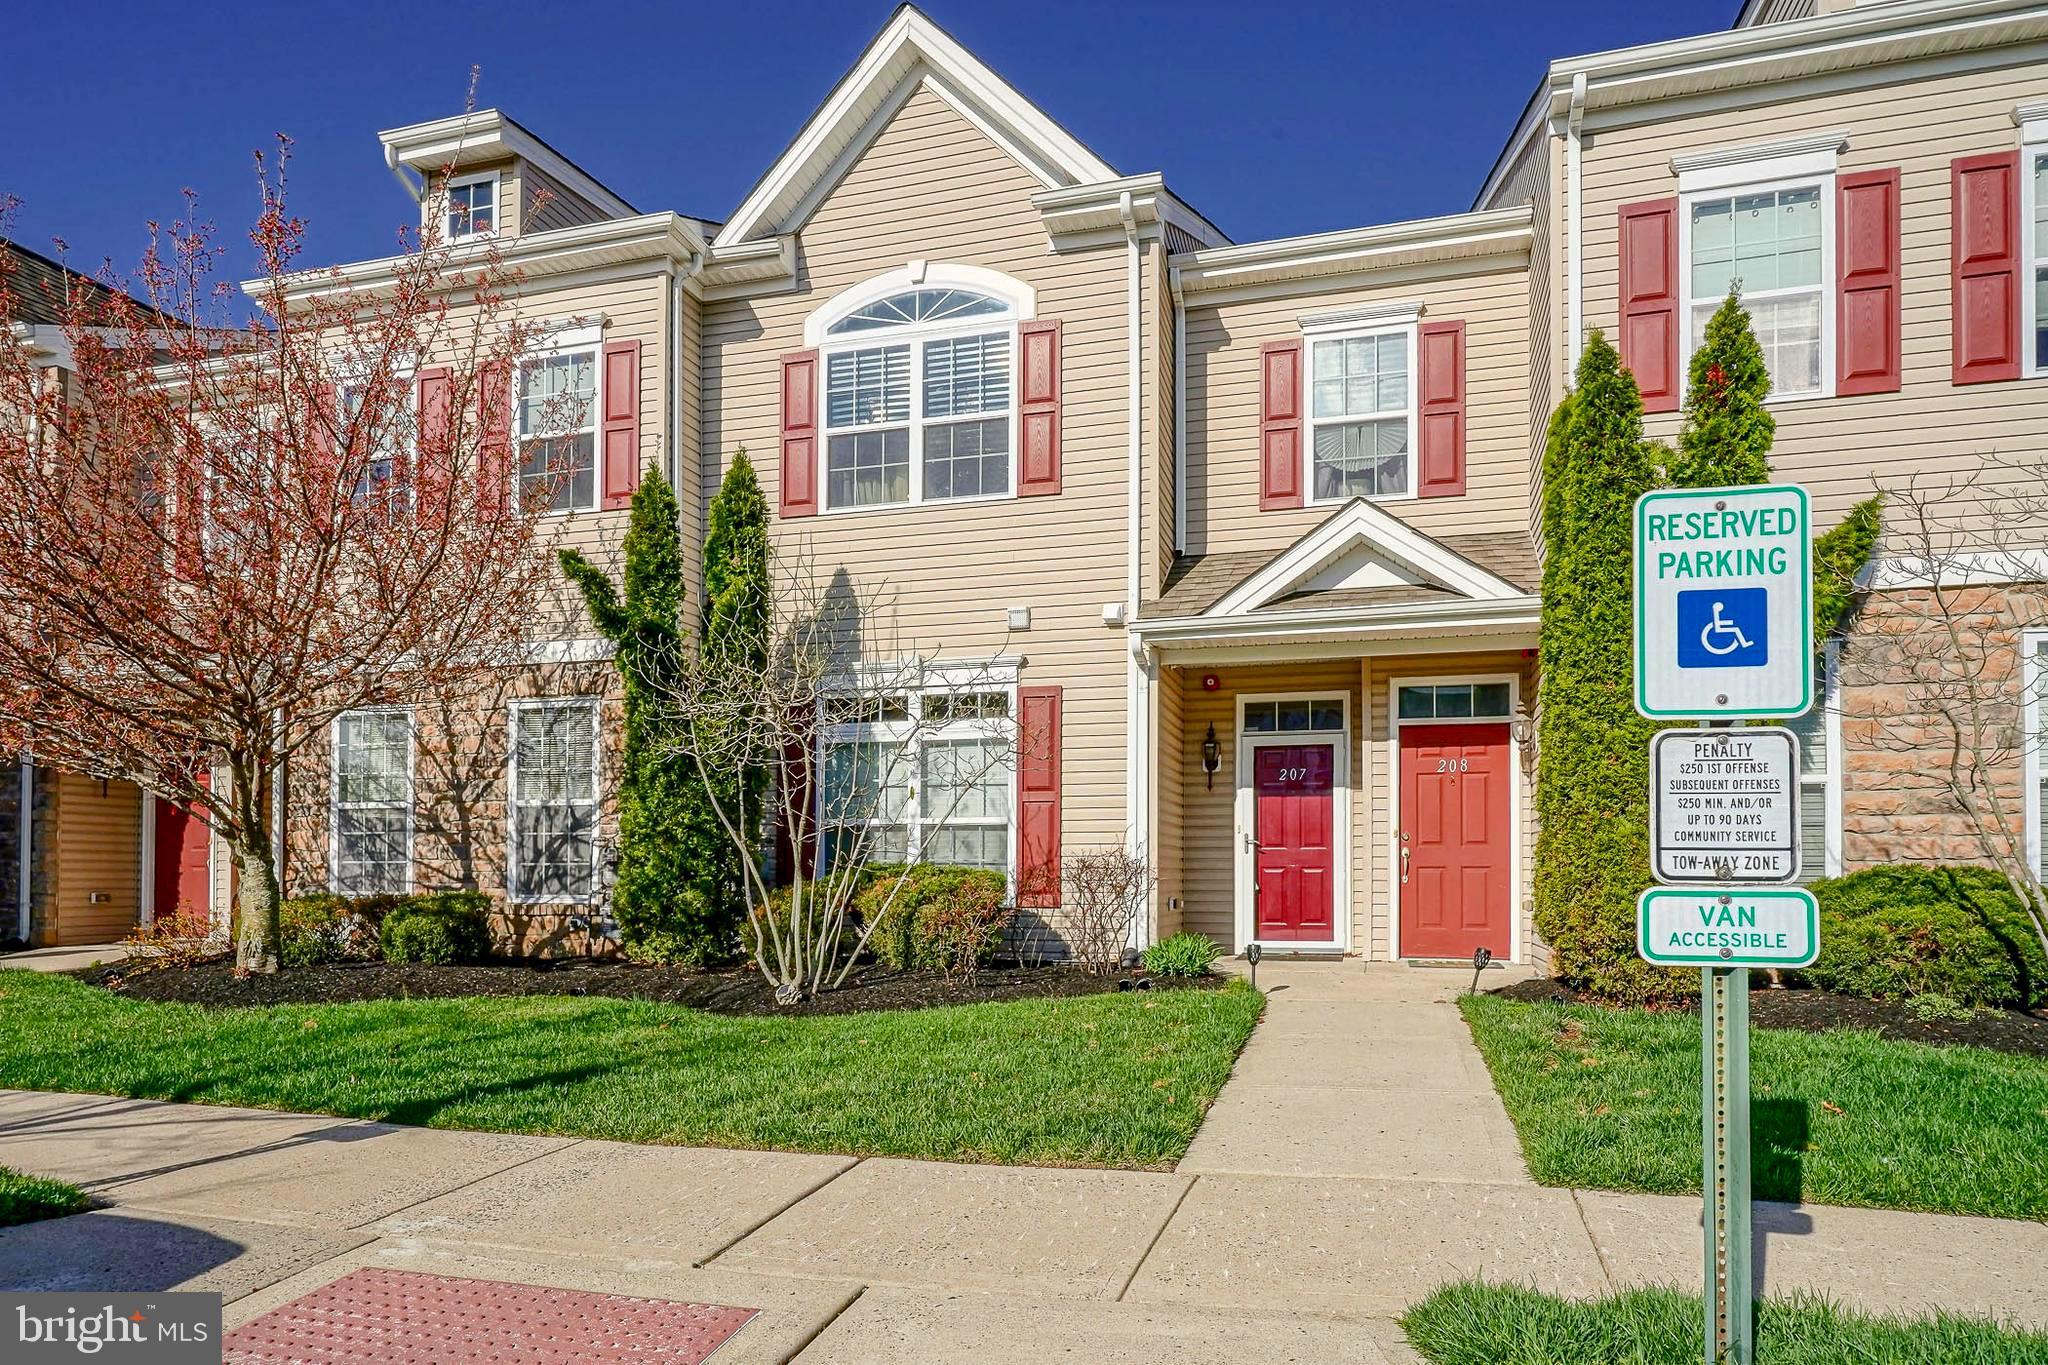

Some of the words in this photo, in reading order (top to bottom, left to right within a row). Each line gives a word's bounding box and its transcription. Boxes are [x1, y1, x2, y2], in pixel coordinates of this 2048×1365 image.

[1649, 508, 1796, 541] RESERVED
[1659, 547, 1787, 579] PARKING
[1694, 743, 1753, 758] PENALTY
[1437, 759, 1468, 773] 208
[1680, 763, 1703, 775] $250
[1725, 763, 1769, 773] OFFENSE
[1279, 768, 1307, 781] 207
[1670, 779, 1729, 791] SUBSEQUENT
[1732, 779, 1780, 790] OFFENSES
[1678, 798, 1701, 809] $250
[1705, 798, 1727, 809] MIN.
[1731, 798, 1772, 809] AND/OR
[1687, 815, 1701, 825] UP
[1704, 814, 1715, 825] TO
[1719, 814, 1732, 825] 90
[1736, 814, 1762, 825] DAYS
[1674, 831, 1731, 842] COMMUNITY
[1735, 831, 1777, 842] SERVICE
[1672, 855, 1739, 870] TOW-AWAY
[1744, 856, 1780, 871] ZONE
[1698, 905, 1756, 927] VAN
[1668, 932, 1788, 948] ACCESSIBLE
